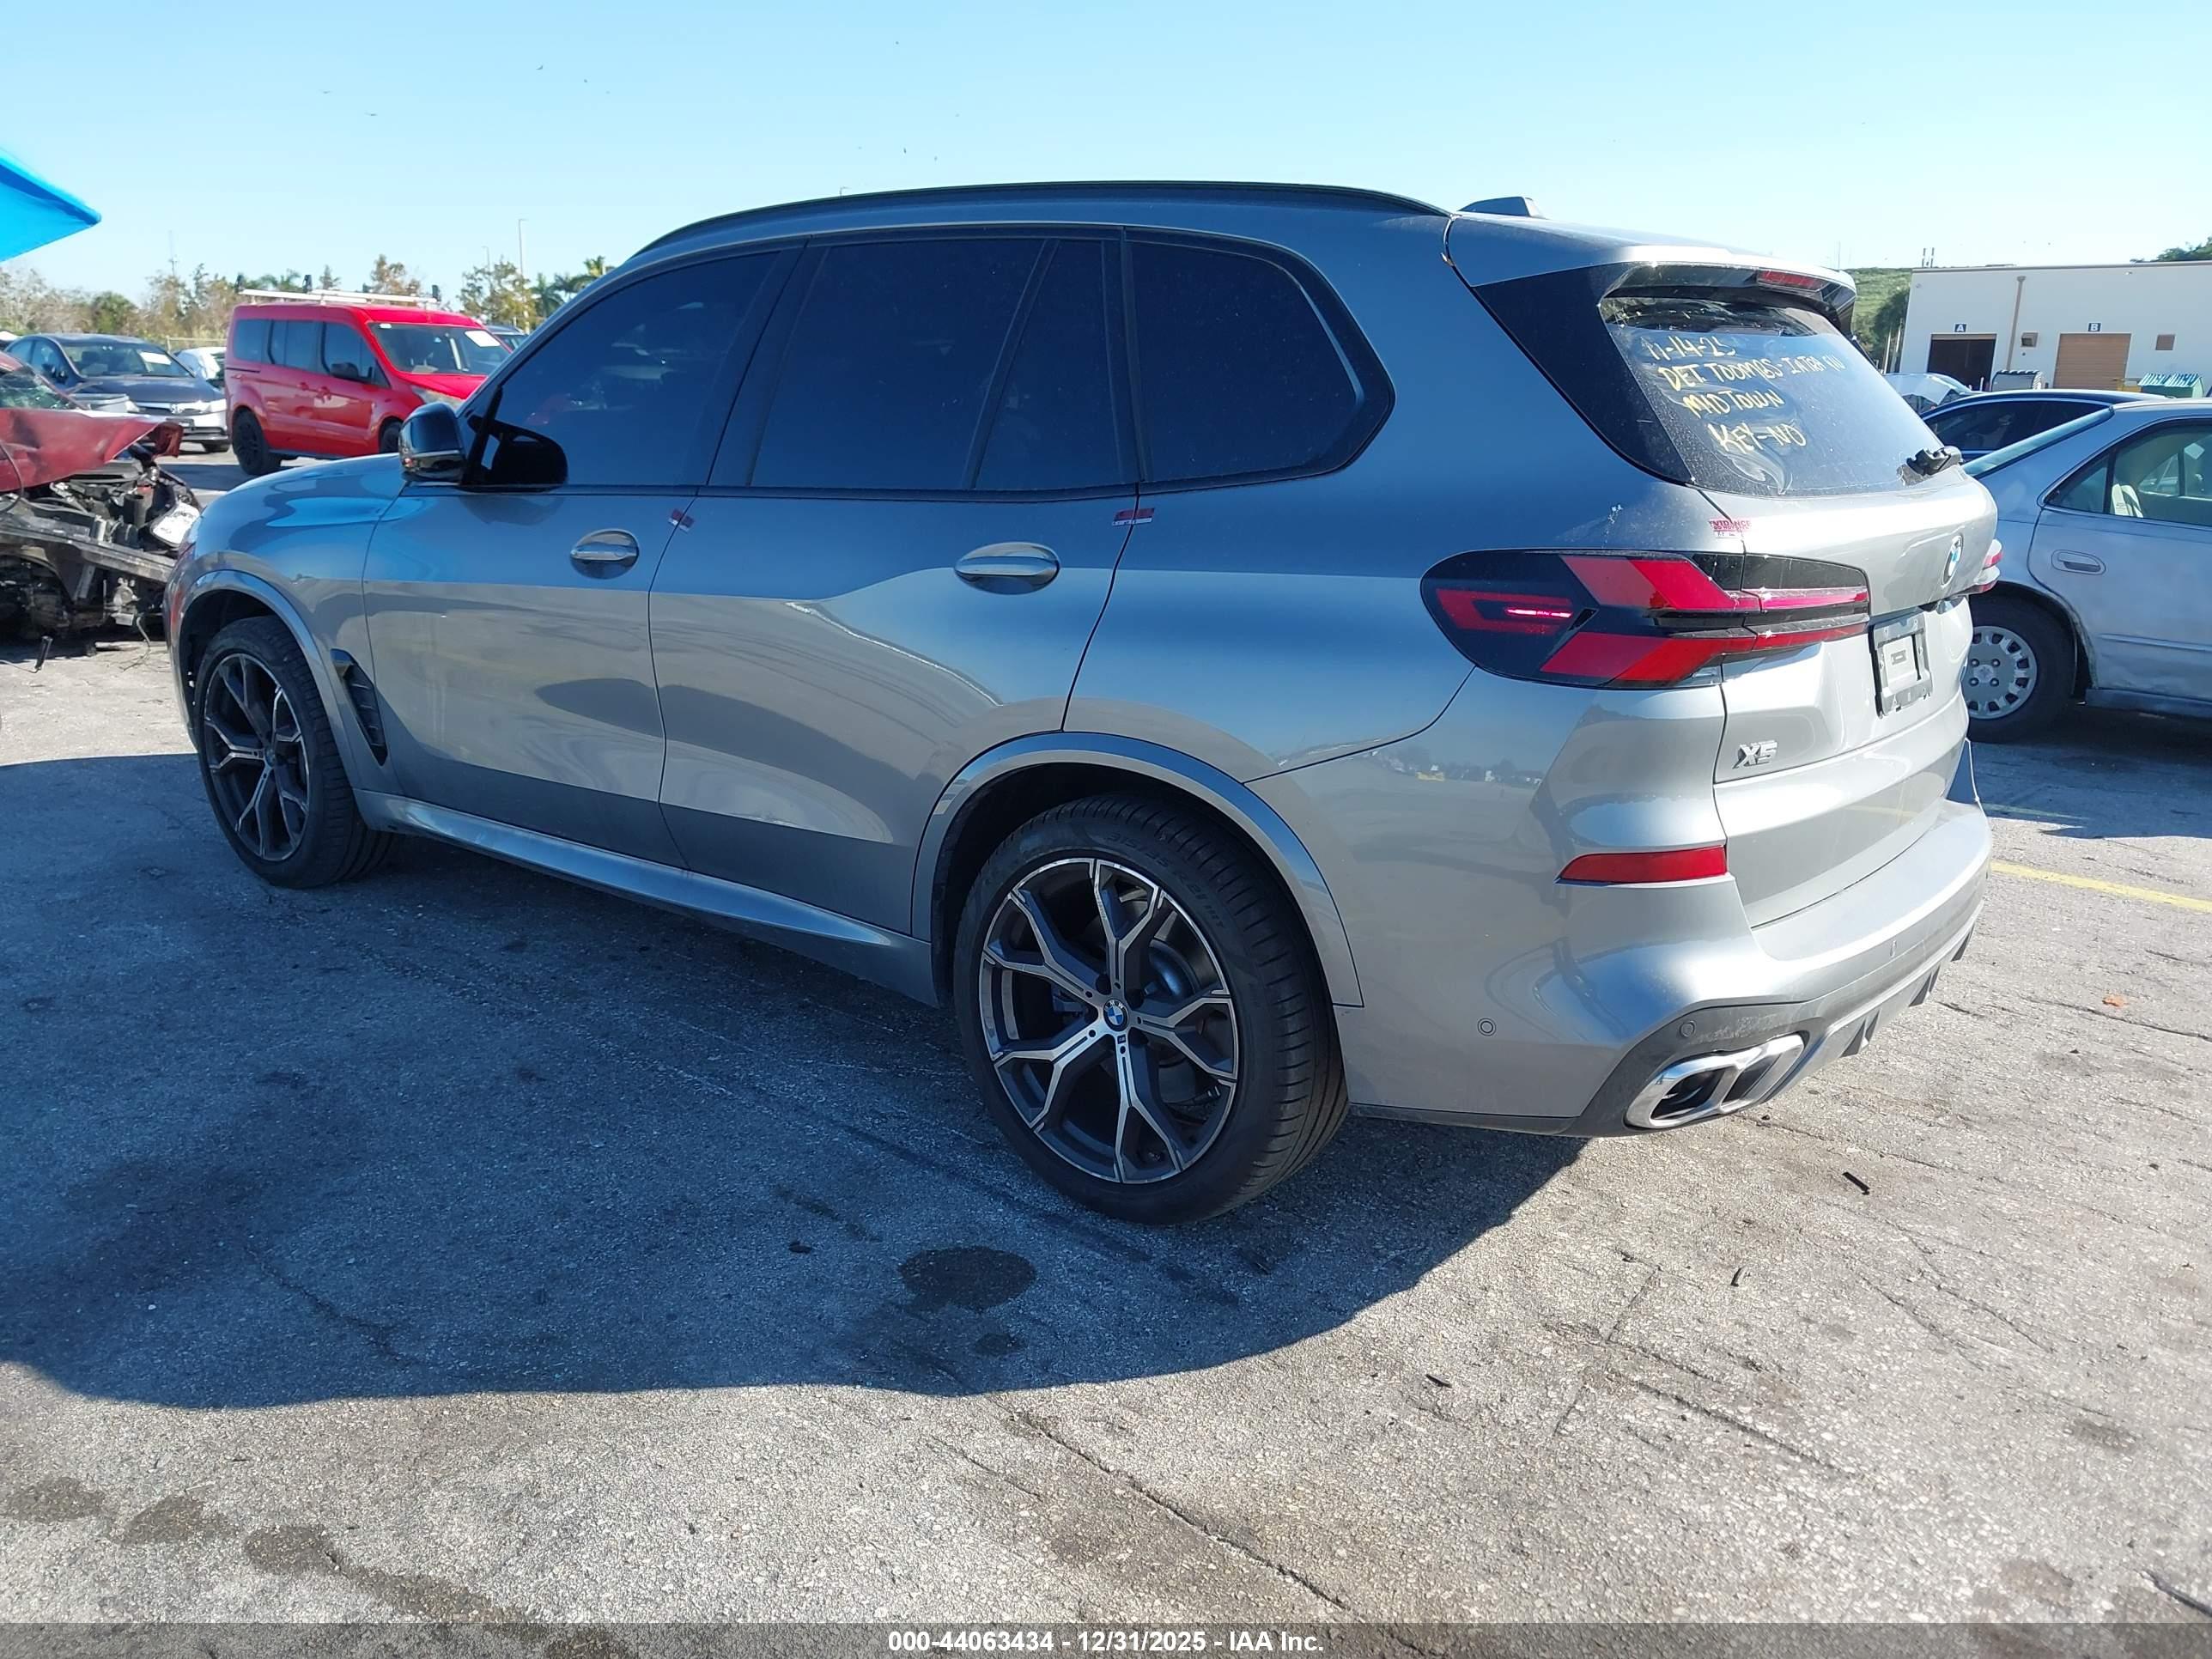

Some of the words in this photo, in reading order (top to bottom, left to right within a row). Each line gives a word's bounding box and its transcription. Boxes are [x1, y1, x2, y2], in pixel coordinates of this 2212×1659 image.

[1957, 324, 1966, 332] A
[2090, 323, 2100, 332] B
[1640, 336, 1736, 361] 11-14-25
[1732, 739, 1778, 769] X5
